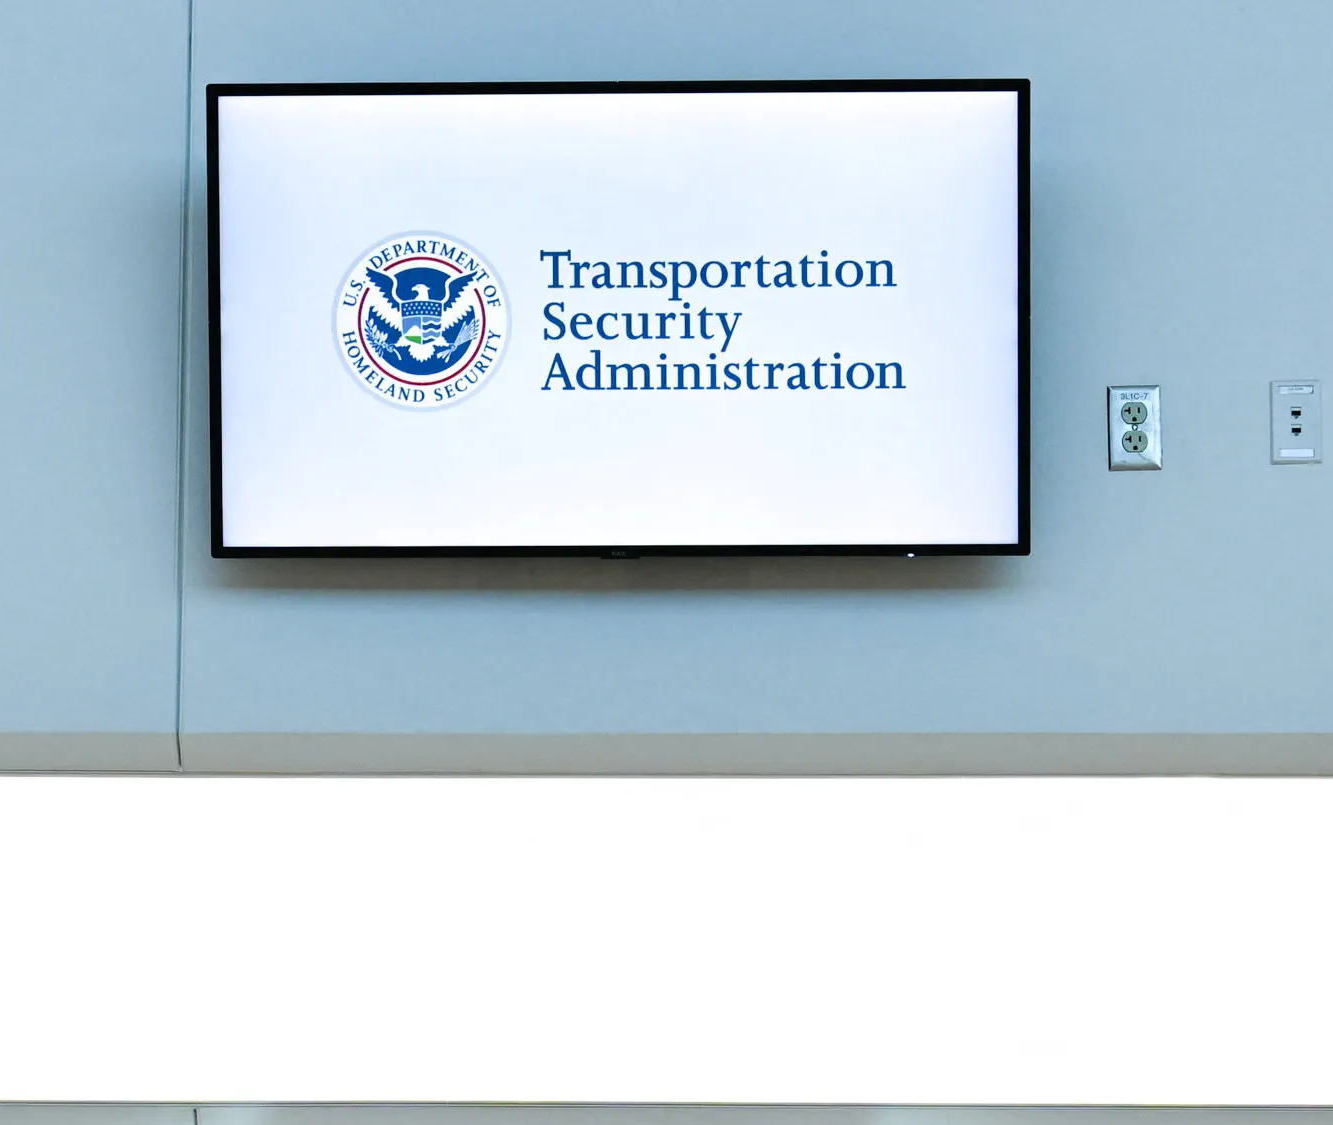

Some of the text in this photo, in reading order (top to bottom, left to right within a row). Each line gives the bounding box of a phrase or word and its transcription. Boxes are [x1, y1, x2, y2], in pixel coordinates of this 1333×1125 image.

[343, 240, 501, 308] U.S. DEPARTMENT OF
[540, 249, 897, 301] Transportation
[543, 302, 742, 352] Security
[342, 329, 501, 403] HOMELAND SECURITY
[541, 350, 907, 391] Administration
